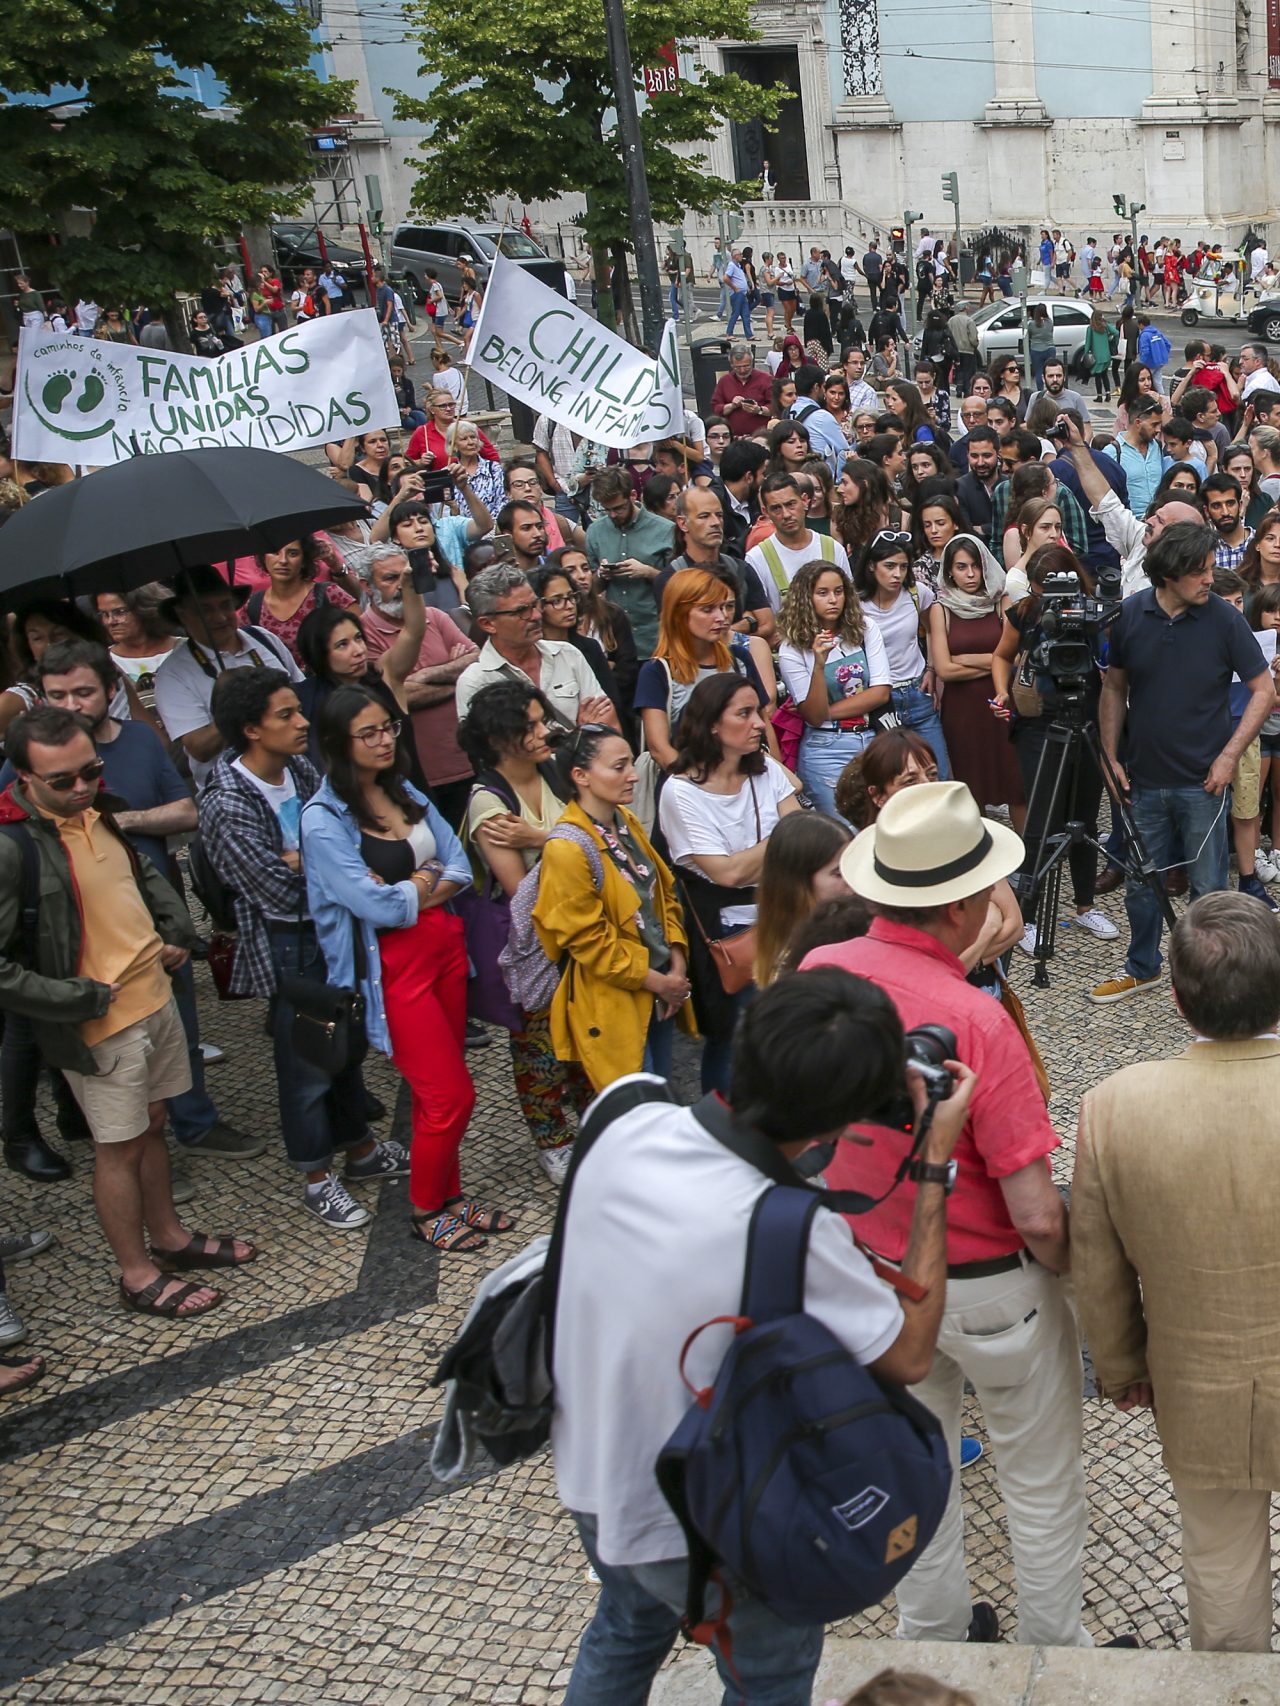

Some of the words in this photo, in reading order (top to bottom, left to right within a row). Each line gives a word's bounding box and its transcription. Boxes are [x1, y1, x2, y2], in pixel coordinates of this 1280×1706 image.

[648, 66, 676, 81] 1518
[33, 339, 85, 359] caminhos
[479, 334, 572, 408] BELONG
[567, 390, 602, 425] IN
[149, 385, 270, 436] UNIDAS
